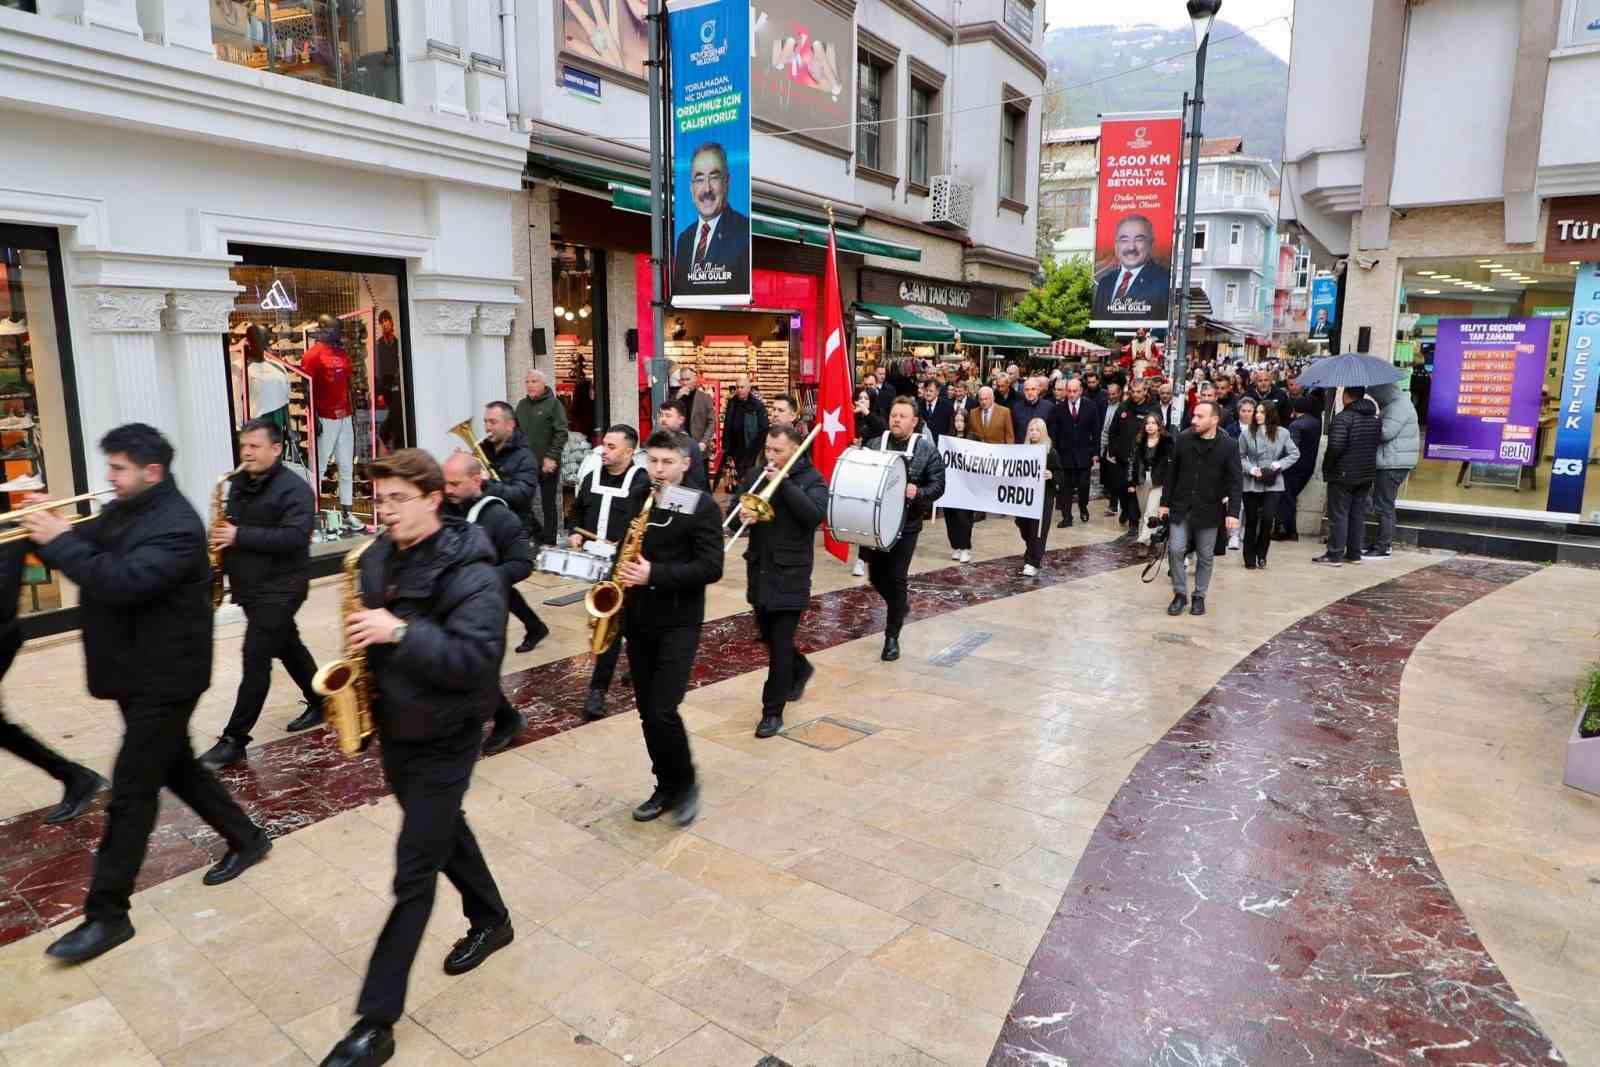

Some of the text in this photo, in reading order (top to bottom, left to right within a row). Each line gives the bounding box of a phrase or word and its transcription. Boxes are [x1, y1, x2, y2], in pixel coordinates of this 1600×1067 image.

[697, 85, 733, 100] DURMADAN
[676, 98, 722, 118] ORDU'MUZ
[681, 109, 737, 132] ÇALIŞIYORUZ
[1107, 153, 1172, 167] 2.600 KM
[1107, 177, 1167, 188] BETON YOL
[948, 287, 971, 309] SHOP
[1564, 336, 1591, 430] DESTEK
[1501, 441, 1531, 462] selfy
[943, 449, 999, 476] OKSİJENİN
[997, 485, 1034, 506] ORDU
